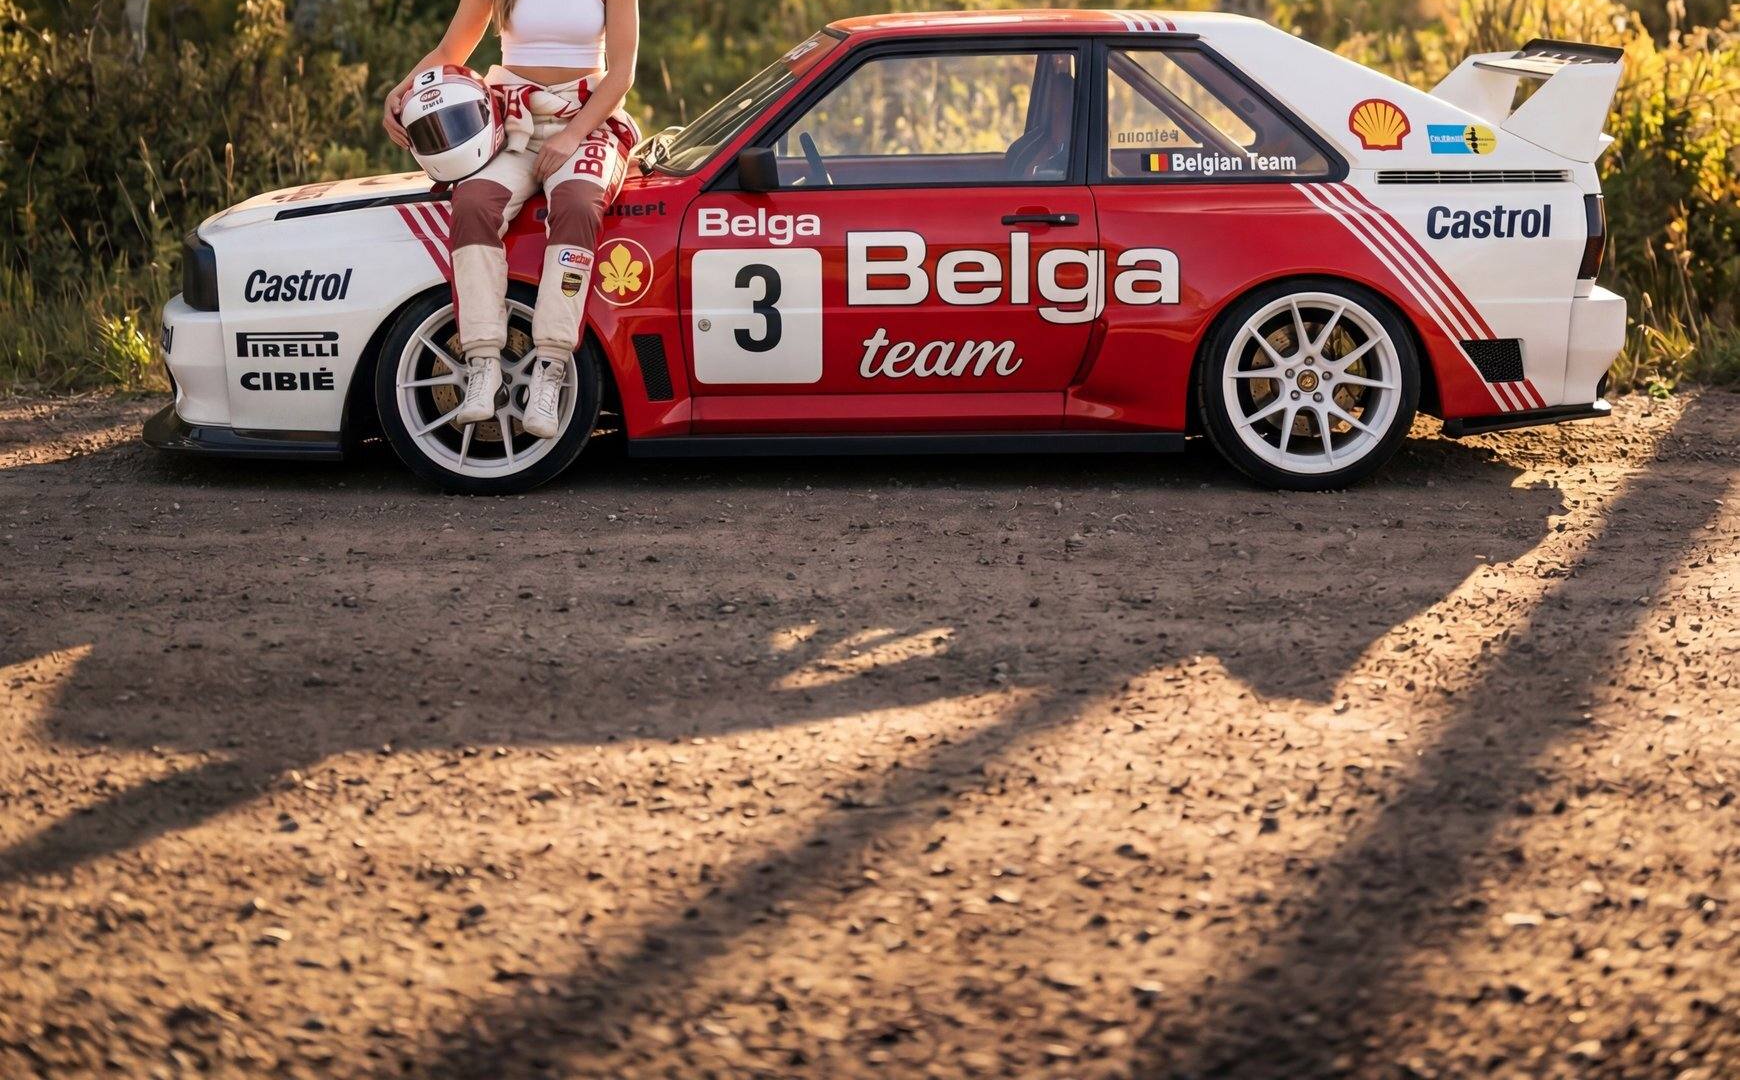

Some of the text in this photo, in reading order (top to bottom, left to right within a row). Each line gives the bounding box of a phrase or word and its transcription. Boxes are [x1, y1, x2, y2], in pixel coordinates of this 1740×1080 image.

[420, 71, 435, 86] 3
[1172, 152, 1297, 176] Belgian Team
[698, 207, 821, 245] Belga
[1426, 204, 1552, 240] Castrol
[244, 268, 353, 303] Castrol
[846, 230, 1181, 324] Belga
[733, 263, 783, 352] 3
[236, 331, 339, 358] PIRELLI
[858, 327, 1024, 379] team
[240, 367, 335, 391] CIBIÉ
